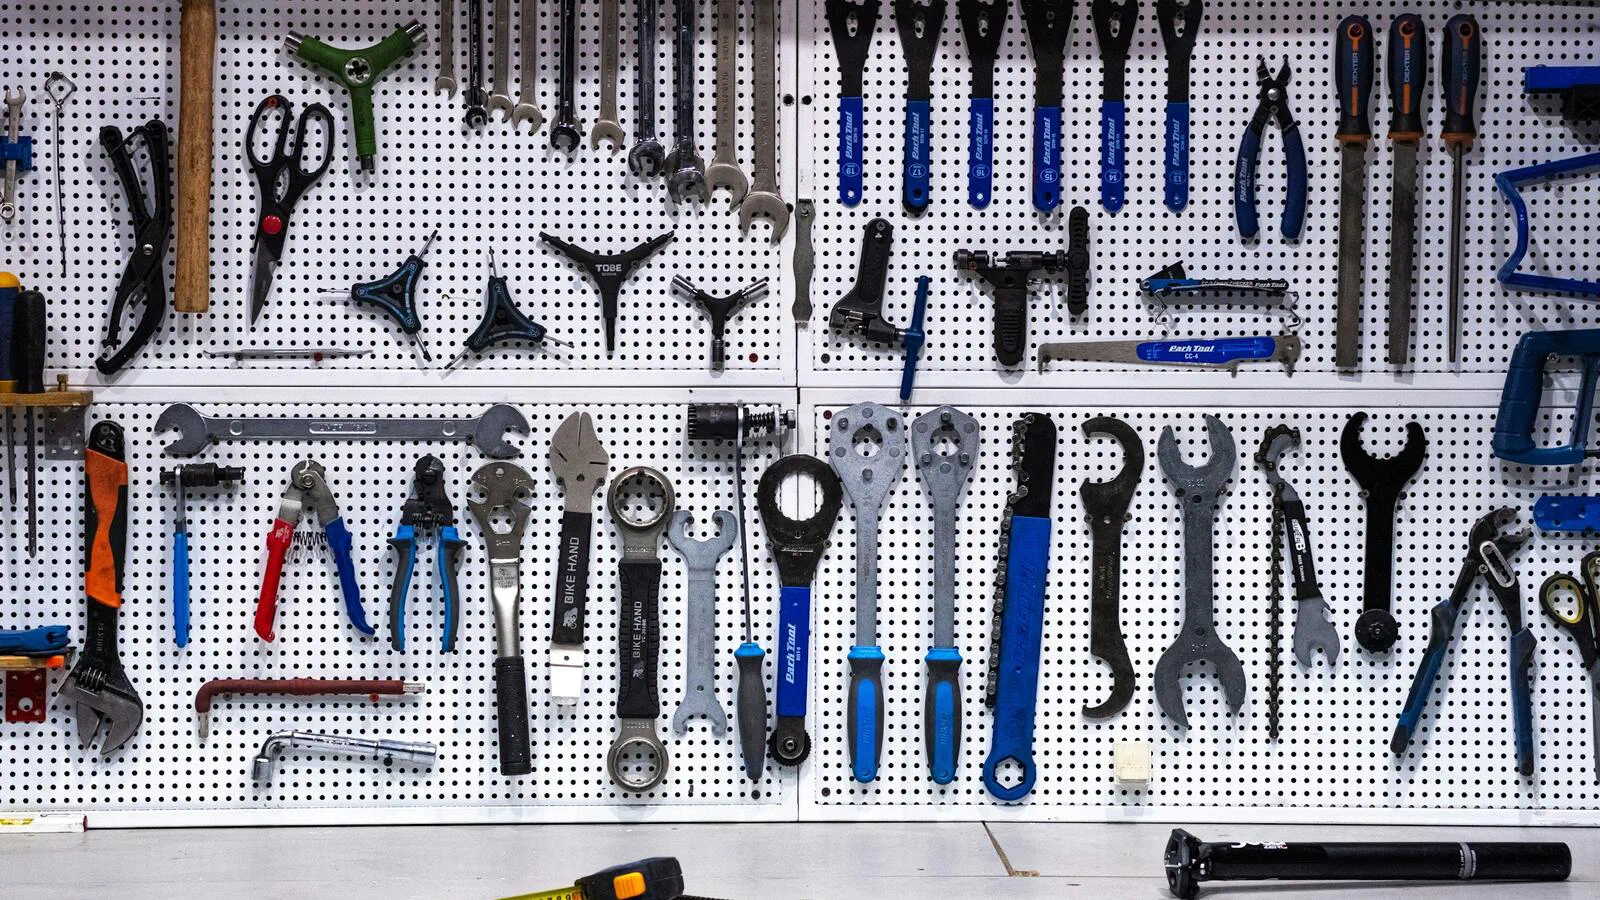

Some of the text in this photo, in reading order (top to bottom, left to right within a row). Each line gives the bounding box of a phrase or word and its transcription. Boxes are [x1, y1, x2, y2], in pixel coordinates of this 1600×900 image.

[1240, 157, 1248, 180] Tool
[564, 537, 580, 603] BIKE HAND
[633, 601, 642, 658] BIKE HAND
[786, 622, 796, 684] Park Tool
